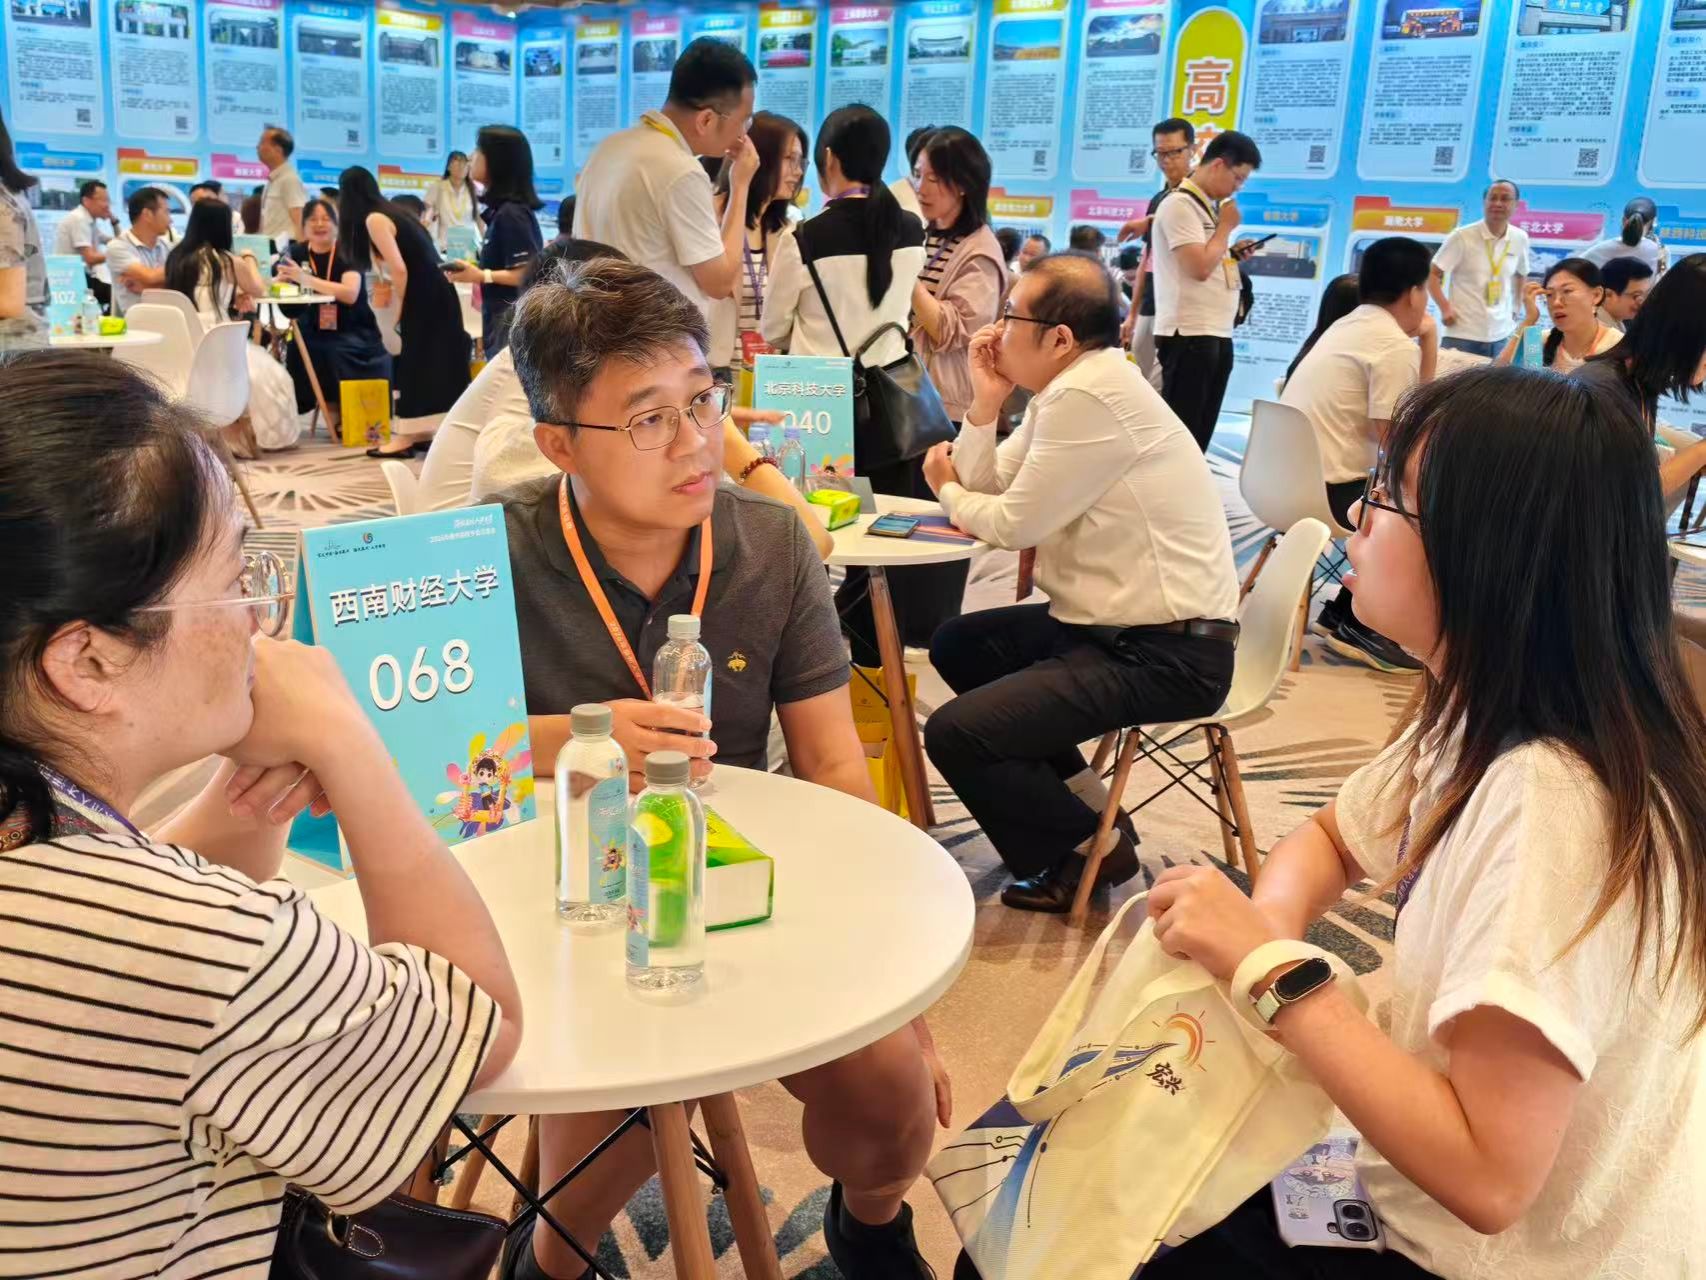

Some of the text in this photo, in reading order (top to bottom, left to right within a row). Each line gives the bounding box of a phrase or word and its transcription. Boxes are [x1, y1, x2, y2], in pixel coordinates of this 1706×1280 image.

[764, 380, 847, 398] 北京科技大学
[780, 410, 832, 435] 040
[330, 564, 499, 627] 西南财经大学
[369, 638, 475, 711] 068
